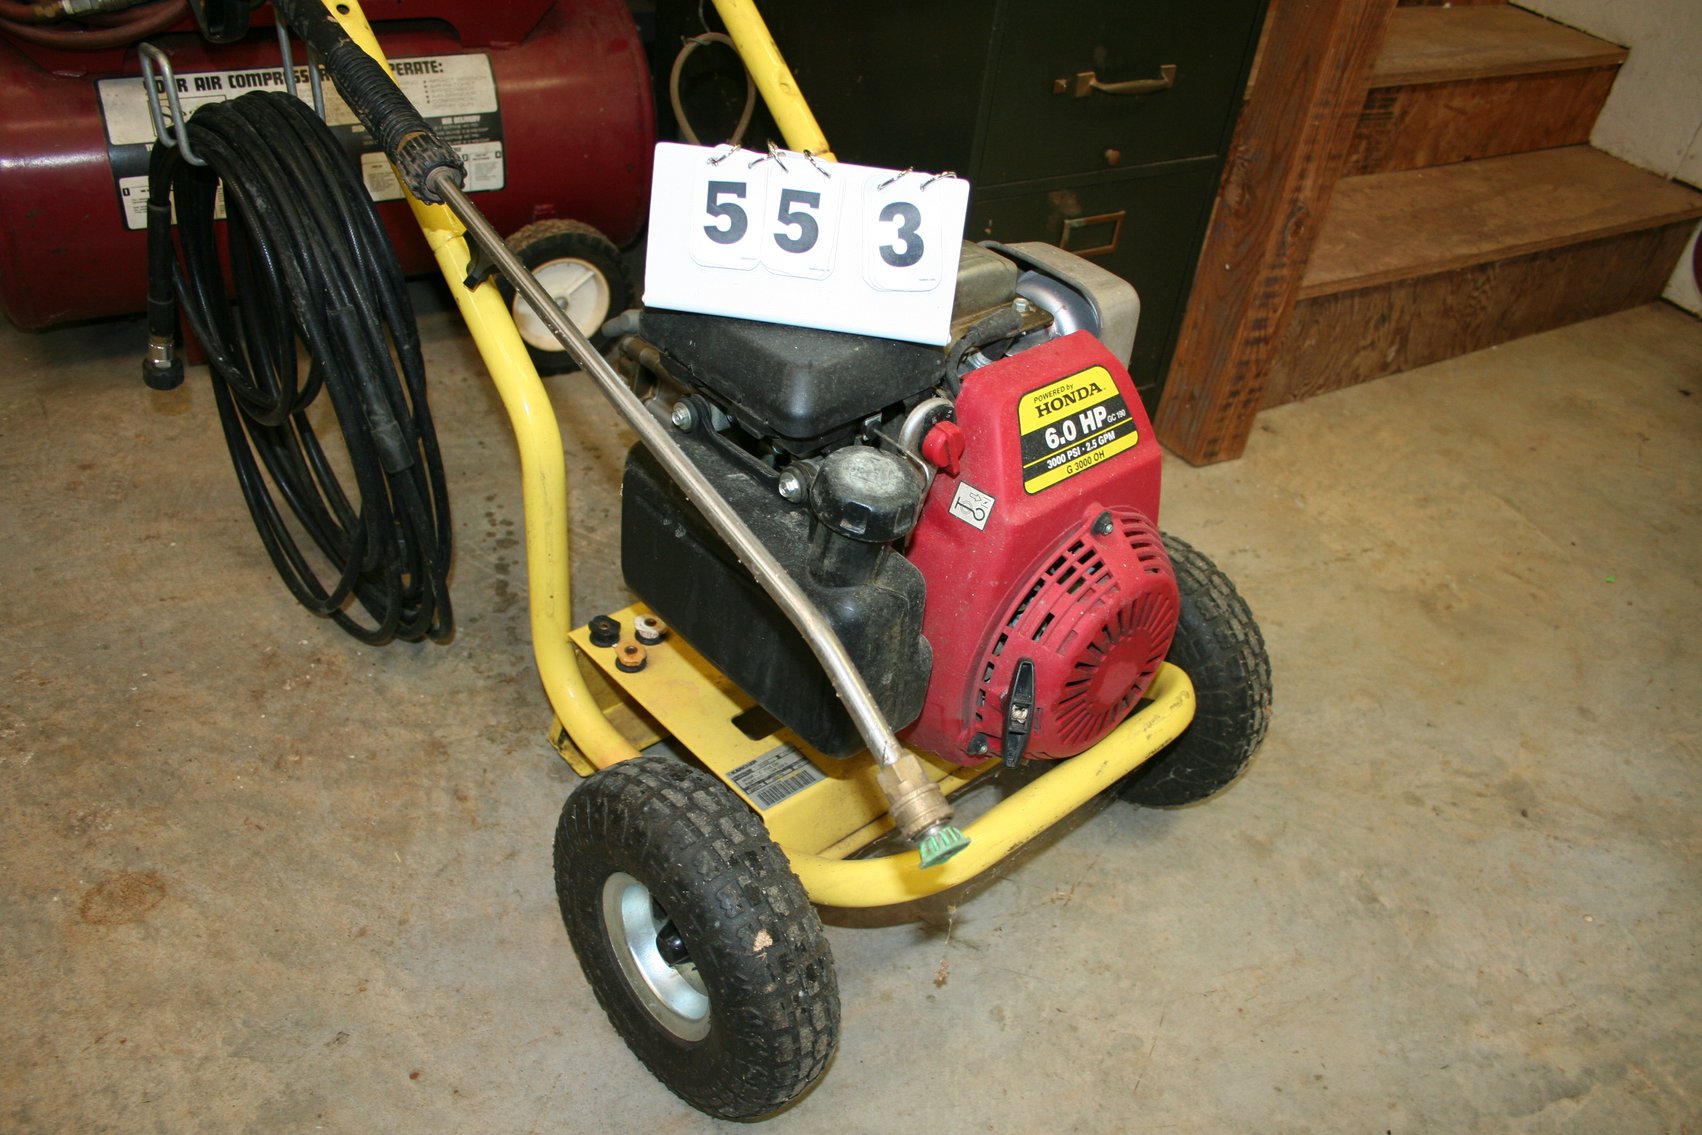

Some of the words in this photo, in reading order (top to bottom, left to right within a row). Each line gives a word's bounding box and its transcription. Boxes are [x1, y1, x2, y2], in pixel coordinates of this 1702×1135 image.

[194, 76, 223, 91] AIR
[228, 68, 331, 89] COMPRSSR
[1033, 386, 1066, 403] POWERED
[1065, 383, 1074, 392] by
[1035, 382, 1103, 418] HONDA
[1044, 421, 1077, 449] 6.0
[1080, 406, 1108, 434] HP
[1046, 453, 1067, 469] 3000
[1067, 447, 1081, 461] PSI
[1085, 438, 1098, 452] 2.5
[1098, 431, 1116, 447] GPM
[1066, 465, 1073, 475] G
[1075, 456, 1093, 472] 3000
[1093, 450, 1105, 464] OH
